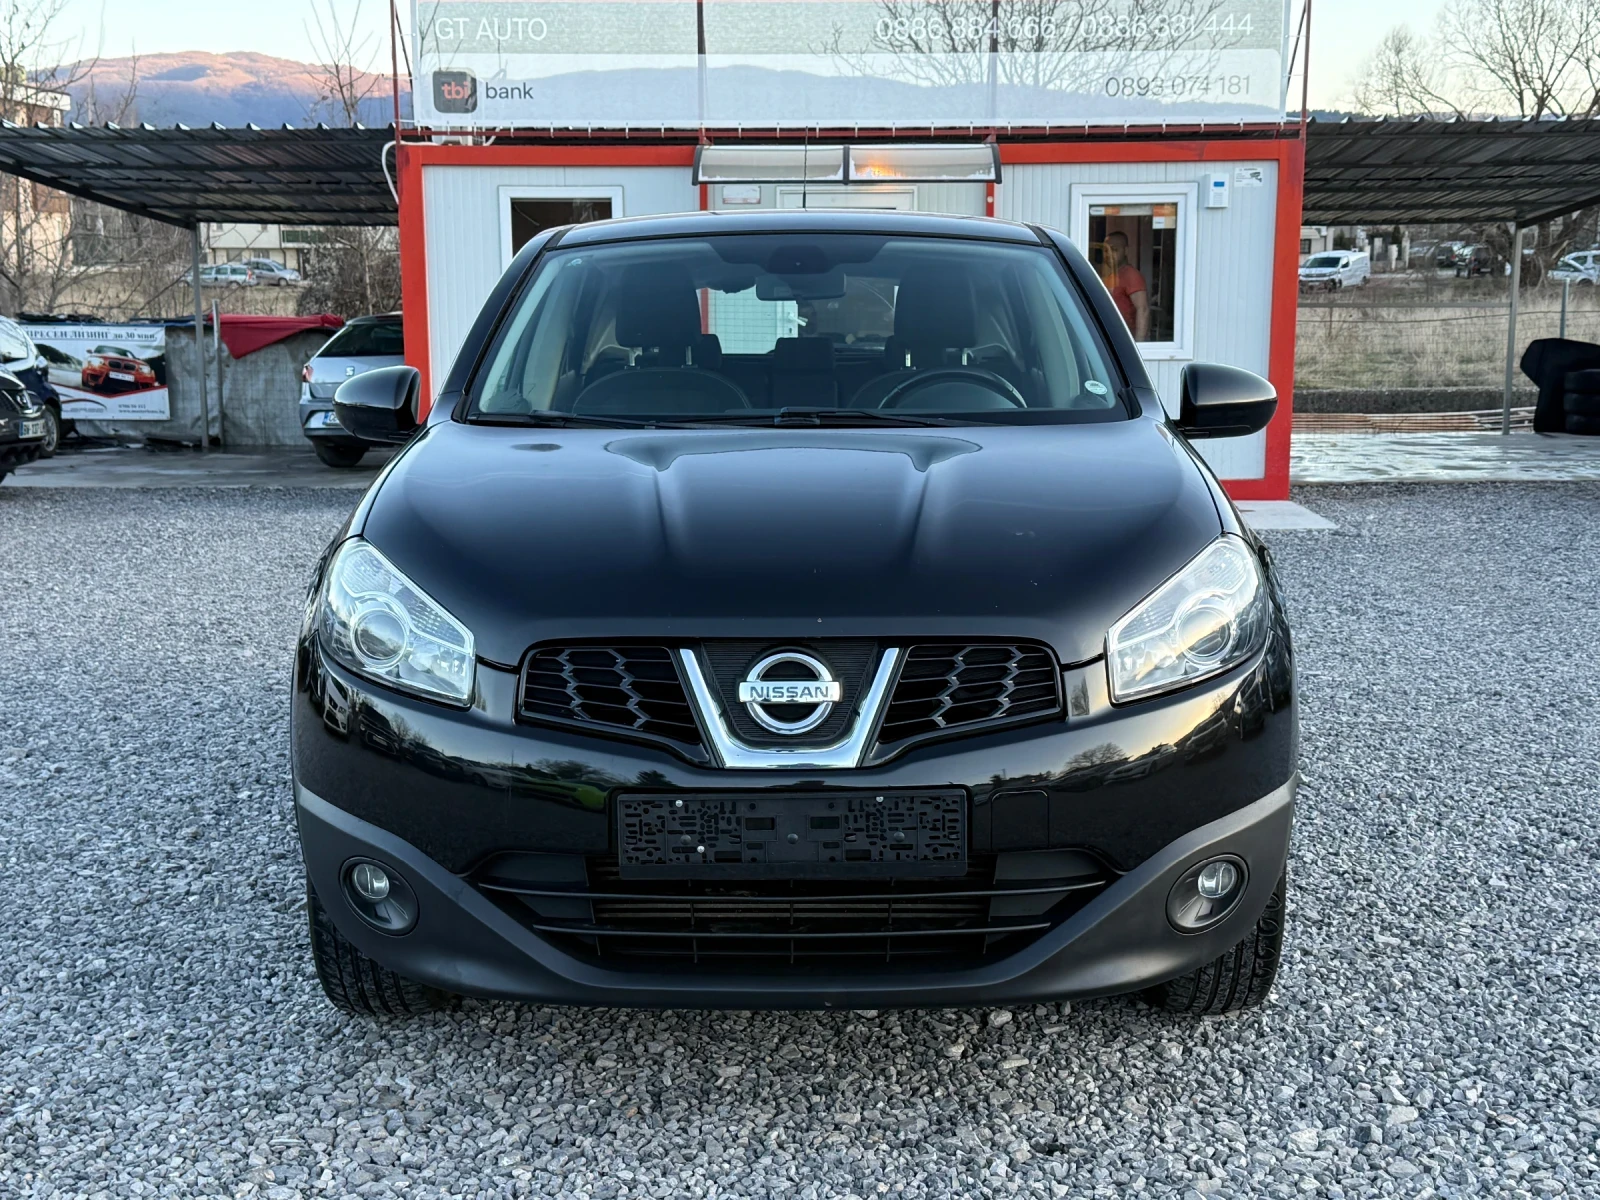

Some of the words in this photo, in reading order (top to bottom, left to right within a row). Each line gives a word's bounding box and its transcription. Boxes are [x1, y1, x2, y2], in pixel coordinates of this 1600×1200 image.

[435, 17, 469, 40] GT
[475, 17, 547, 40] AUTO
[876, 17, 943, 39] 0886
[951, 16, 1000, 39] 884
[1008, 16, 1056, 38] 666
[1081, 15, 1147, 37] 0886
[1204, 13, 1254, 35] 444
[442, 81, 469, 99] tbi
[485, 82, 534, 100] bank
[1105, 77, 1164, 97] 0893
[1171, 76, 1211, 96] 074
[1218, 75, 1251, 95] 181
[750, 686, 829, 699] NISSAN
